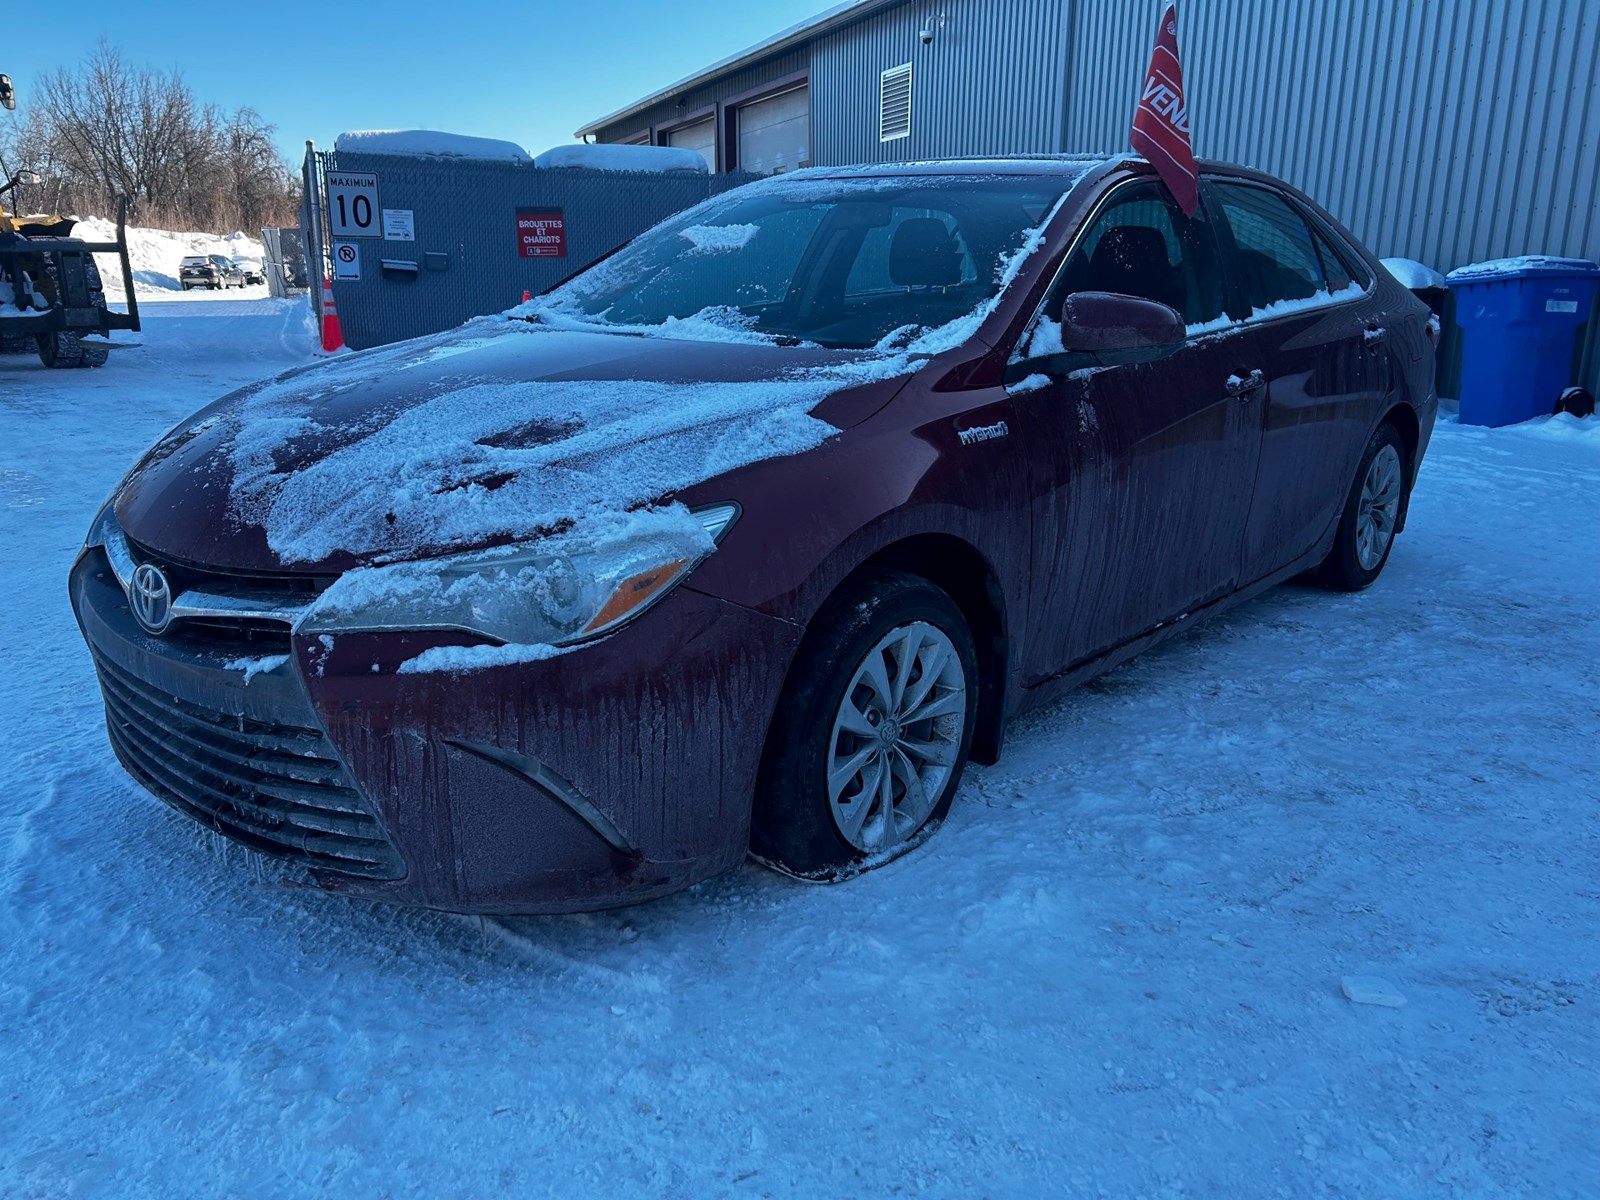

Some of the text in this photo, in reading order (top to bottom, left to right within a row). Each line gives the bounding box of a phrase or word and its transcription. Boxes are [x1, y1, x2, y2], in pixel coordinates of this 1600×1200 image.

[330, 177, 375, 187] MAXIMUM
[337, 194, 372, 228] 10
[519, 220, 563, 228] BROUETTES
[537, 228, 546, 236] ET
[523, 235, 560, 243] CHARIOTS
